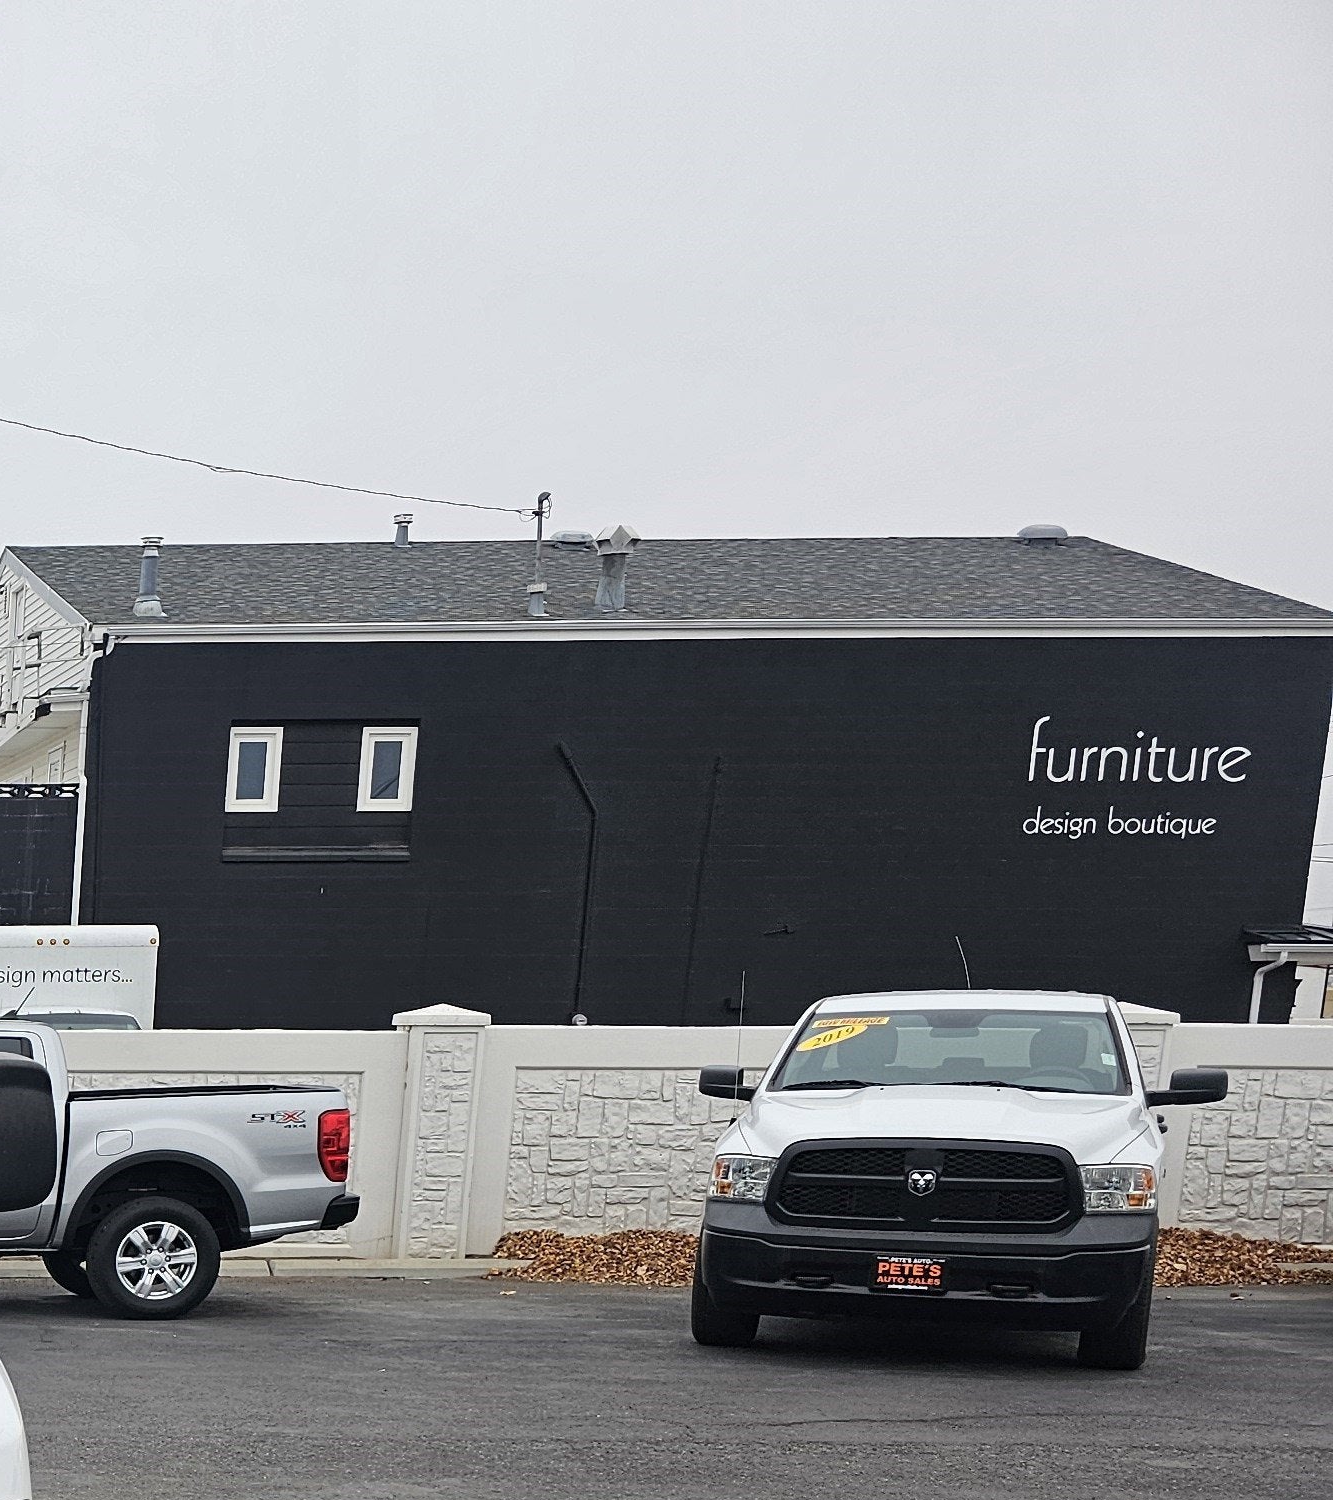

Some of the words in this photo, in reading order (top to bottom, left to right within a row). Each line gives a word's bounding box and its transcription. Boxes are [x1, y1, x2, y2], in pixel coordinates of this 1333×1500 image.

[1028, 716, 1252, 783] furniture
[1022, 806, 1097, 840] design
[1107, 806, 1217, 839] boutique
[42, 967, 133, 983] matters...
[812, 1026, 855, 1047] 2019
[878, 1262, 941, 1276] PETE'S
[908, 1277, 940, 1285] SALES
